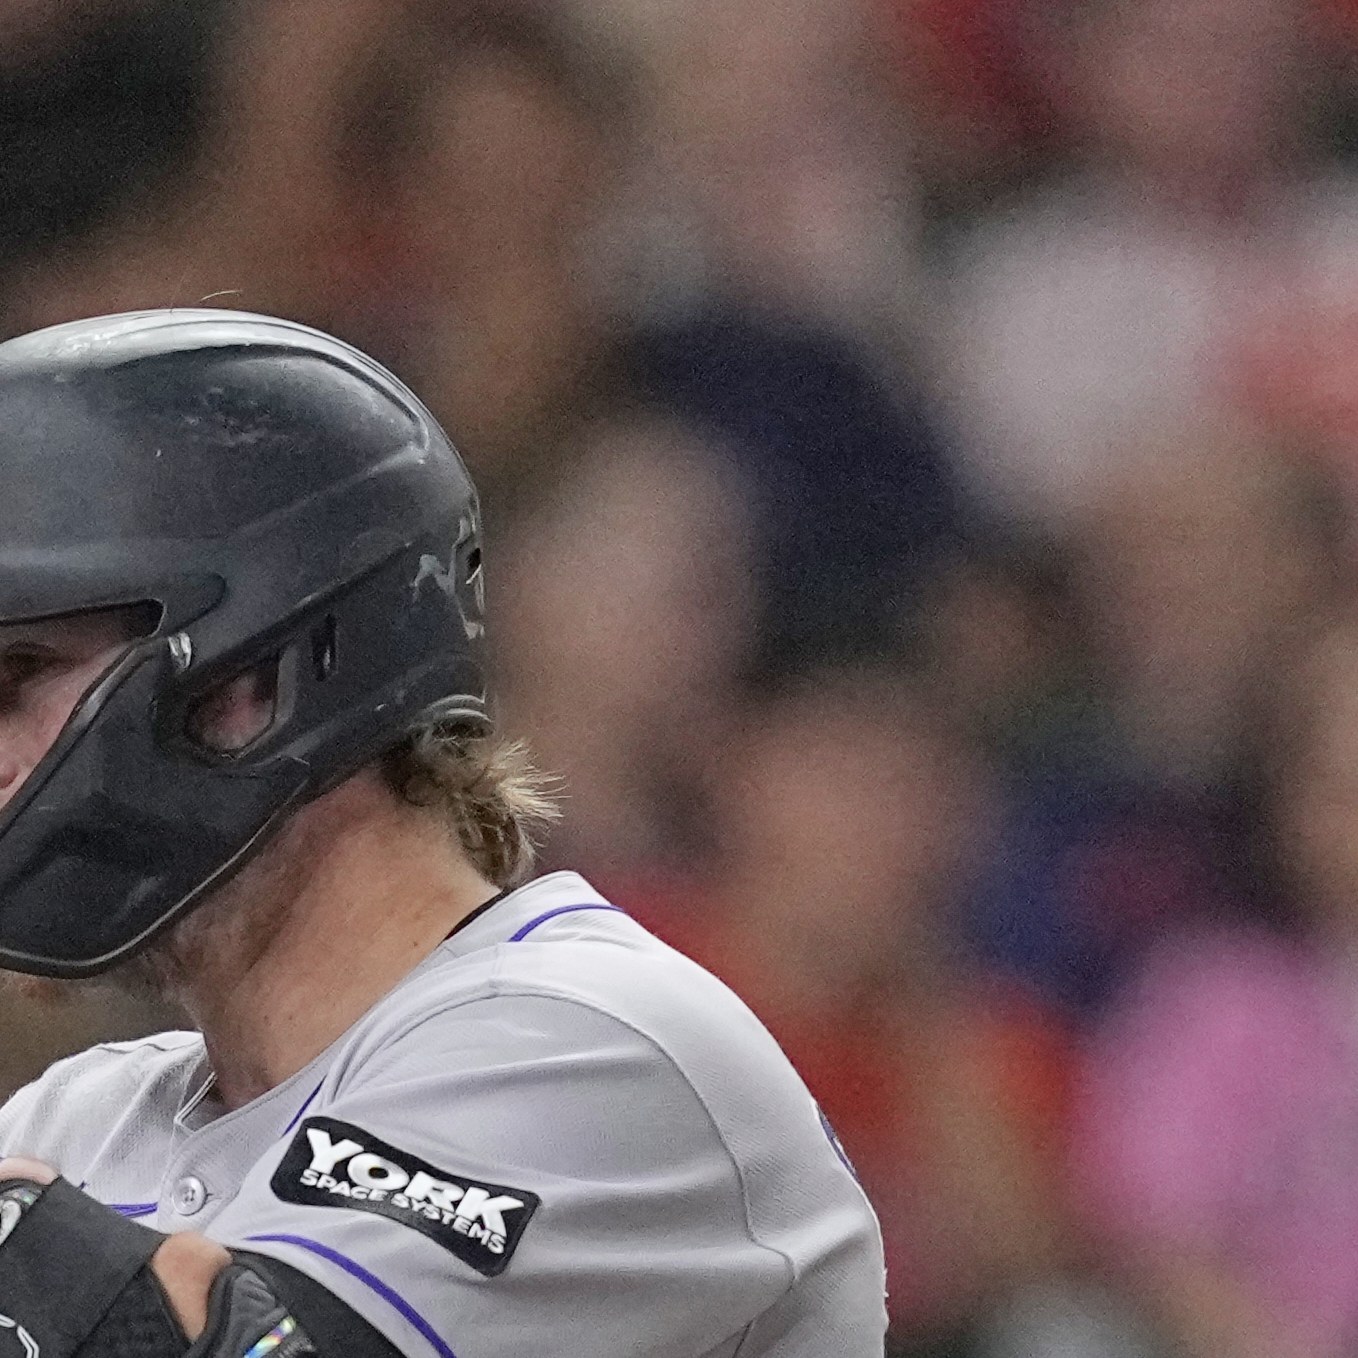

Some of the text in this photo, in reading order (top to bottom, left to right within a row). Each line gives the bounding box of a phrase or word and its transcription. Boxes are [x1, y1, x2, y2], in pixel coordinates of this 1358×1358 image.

[299, 1168, 507, 1255] SPACE SYSTEMS
[306, 1128, 525, 1238] YORK
